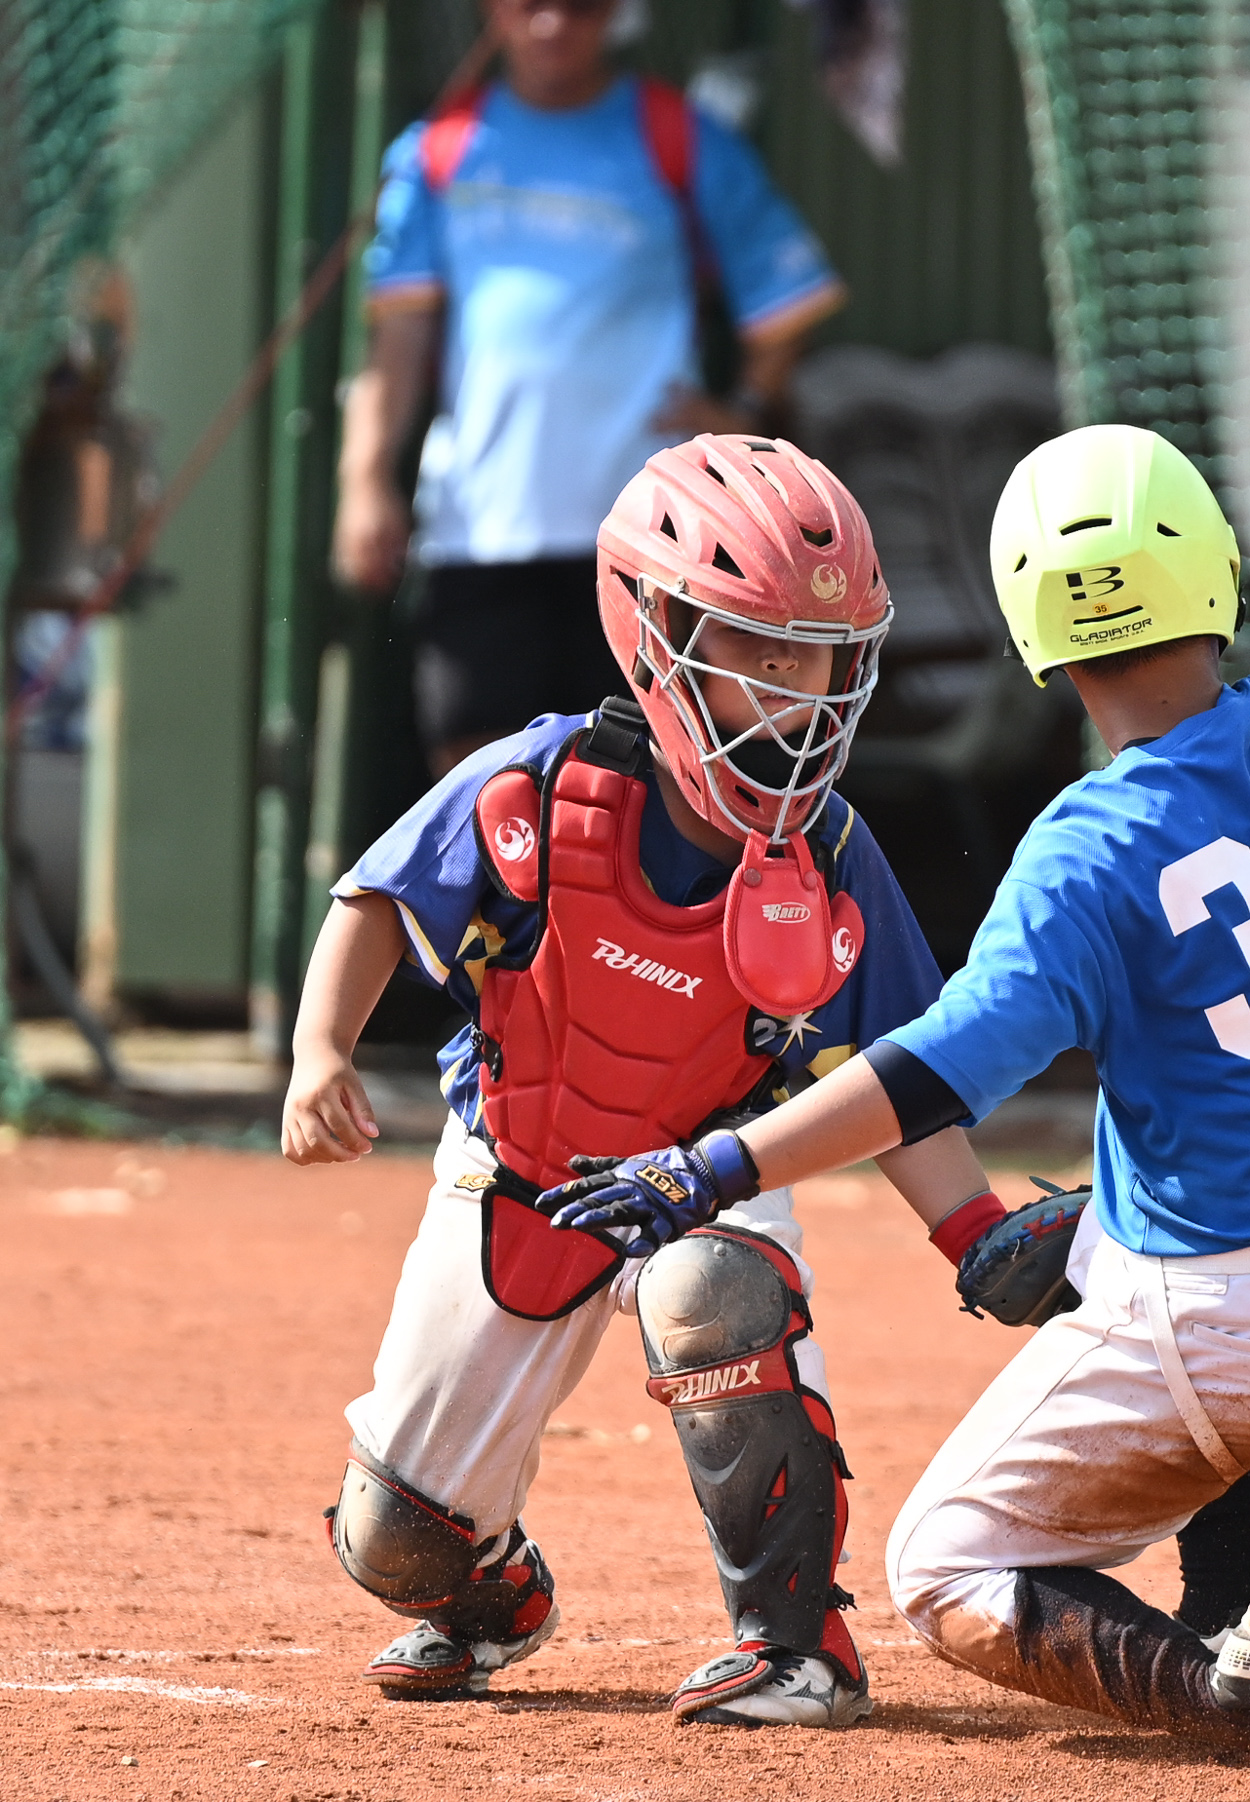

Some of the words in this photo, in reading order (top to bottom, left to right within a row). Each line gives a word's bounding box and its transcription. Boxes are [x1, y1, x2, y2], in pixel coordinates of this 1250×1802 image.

[1094, 604, 1108, 614] 35
[1069, 617, 1153, 643] GLADIATOR
[764, 903, 808, 922] BRETT
[636, 1165, 688, 1203] ZETT
